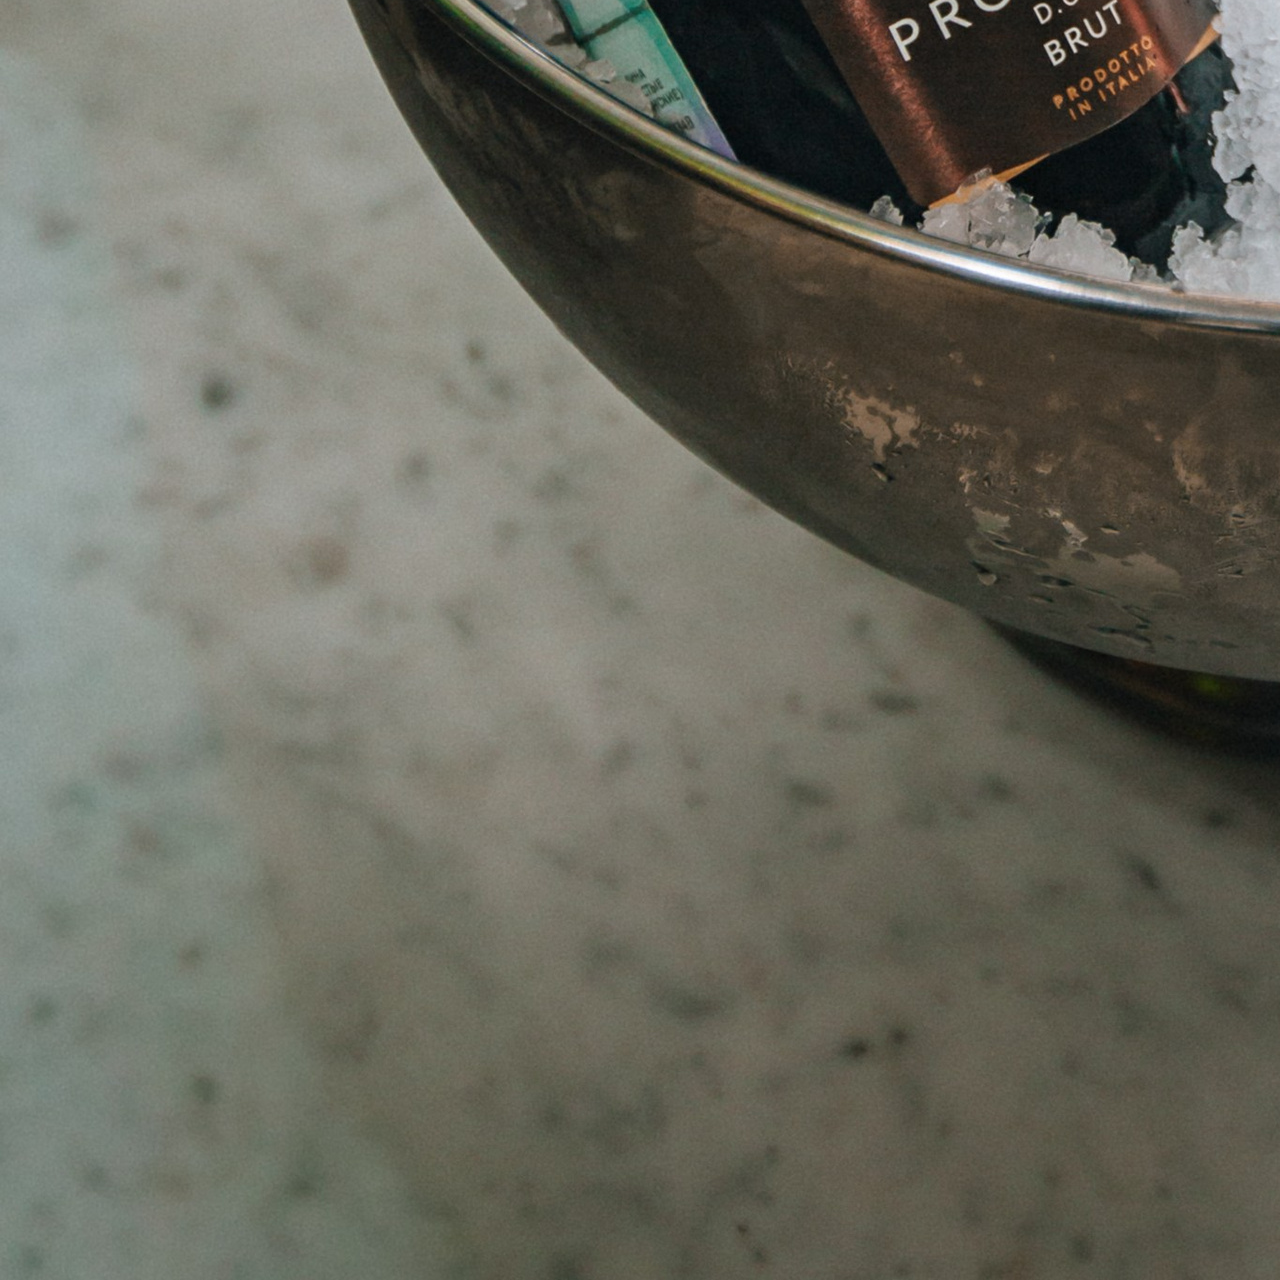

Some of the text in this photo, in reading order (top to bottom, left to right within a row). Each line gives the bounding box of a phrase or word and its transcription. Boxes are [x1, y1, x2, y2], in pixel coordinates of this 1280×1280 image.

[1052, 35, 1154, 110] PRODOTTO
[1069, 56, 1156, 121] IN ITALIA
